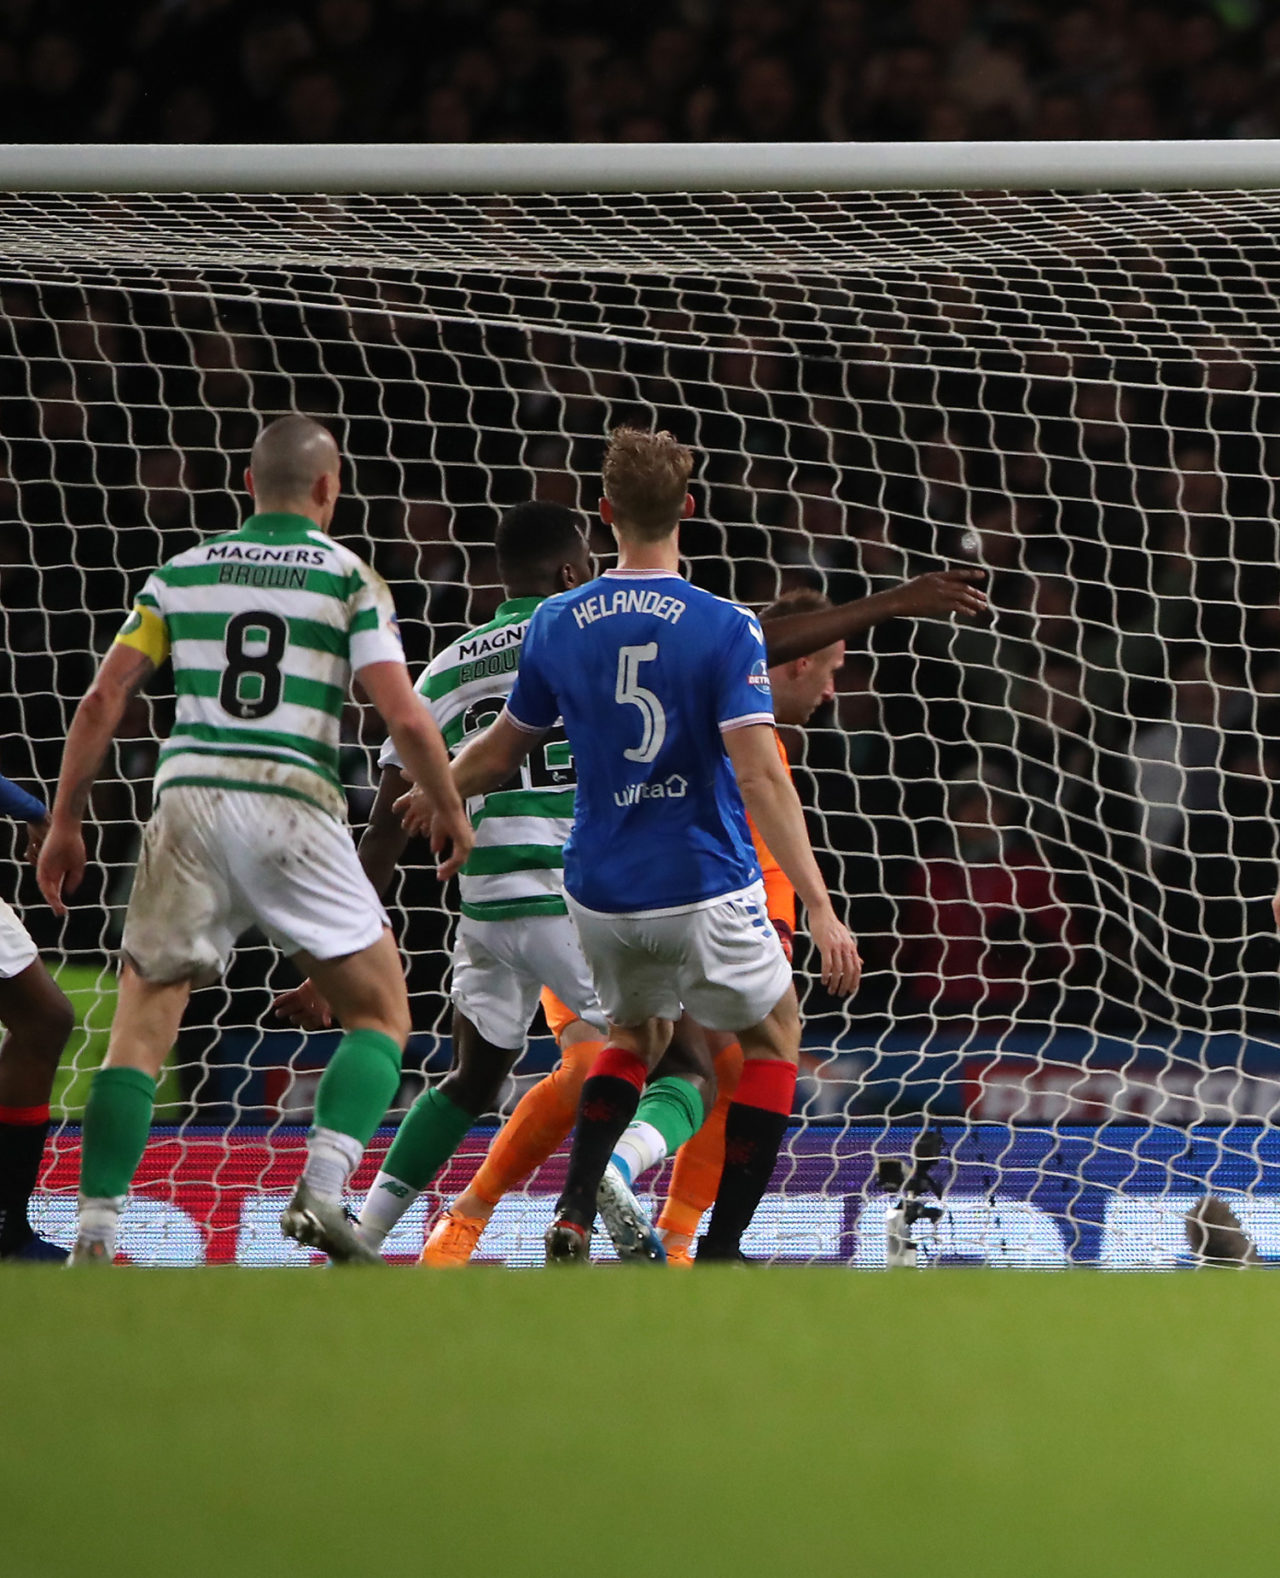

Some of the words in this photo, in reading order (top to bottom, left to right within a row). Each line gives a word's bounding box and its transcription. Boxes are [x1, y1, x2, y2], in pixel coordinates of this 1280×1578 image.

[206, 545, 326, 565] MAGNERS
[219, 562, 308, 588] BROWN
[572, 589, 687, 630] HELANDER
[458, 624, 530, 661] MAGN
[218, 610, 290, 720] 8
[459, 647, 521, 685] EDOU
[615, 641, 666, 763] 5
